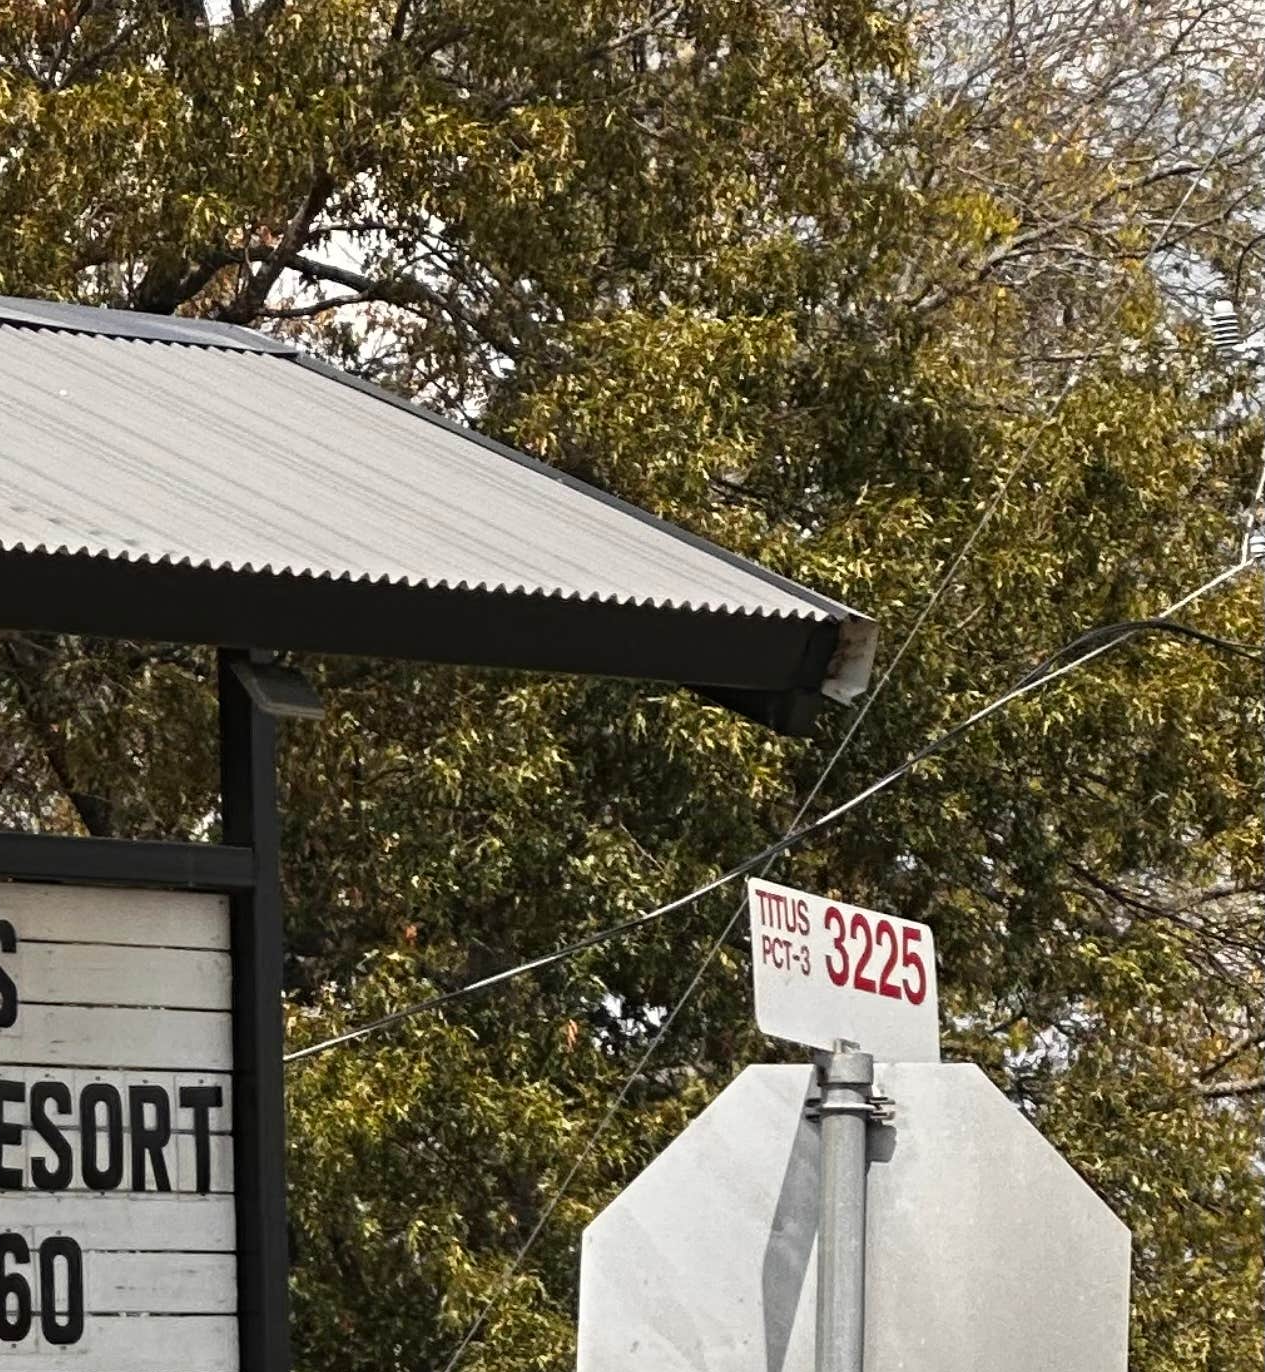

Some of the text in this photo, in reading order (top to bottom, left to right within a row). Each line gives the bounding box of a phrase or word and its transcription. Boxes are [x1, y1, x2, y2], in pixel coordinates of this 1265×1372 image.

[755, 889, 811, 937] TITUS
[762, 934, 811, 977] PCT-3
[824, 906, 927, 1006] 3225
